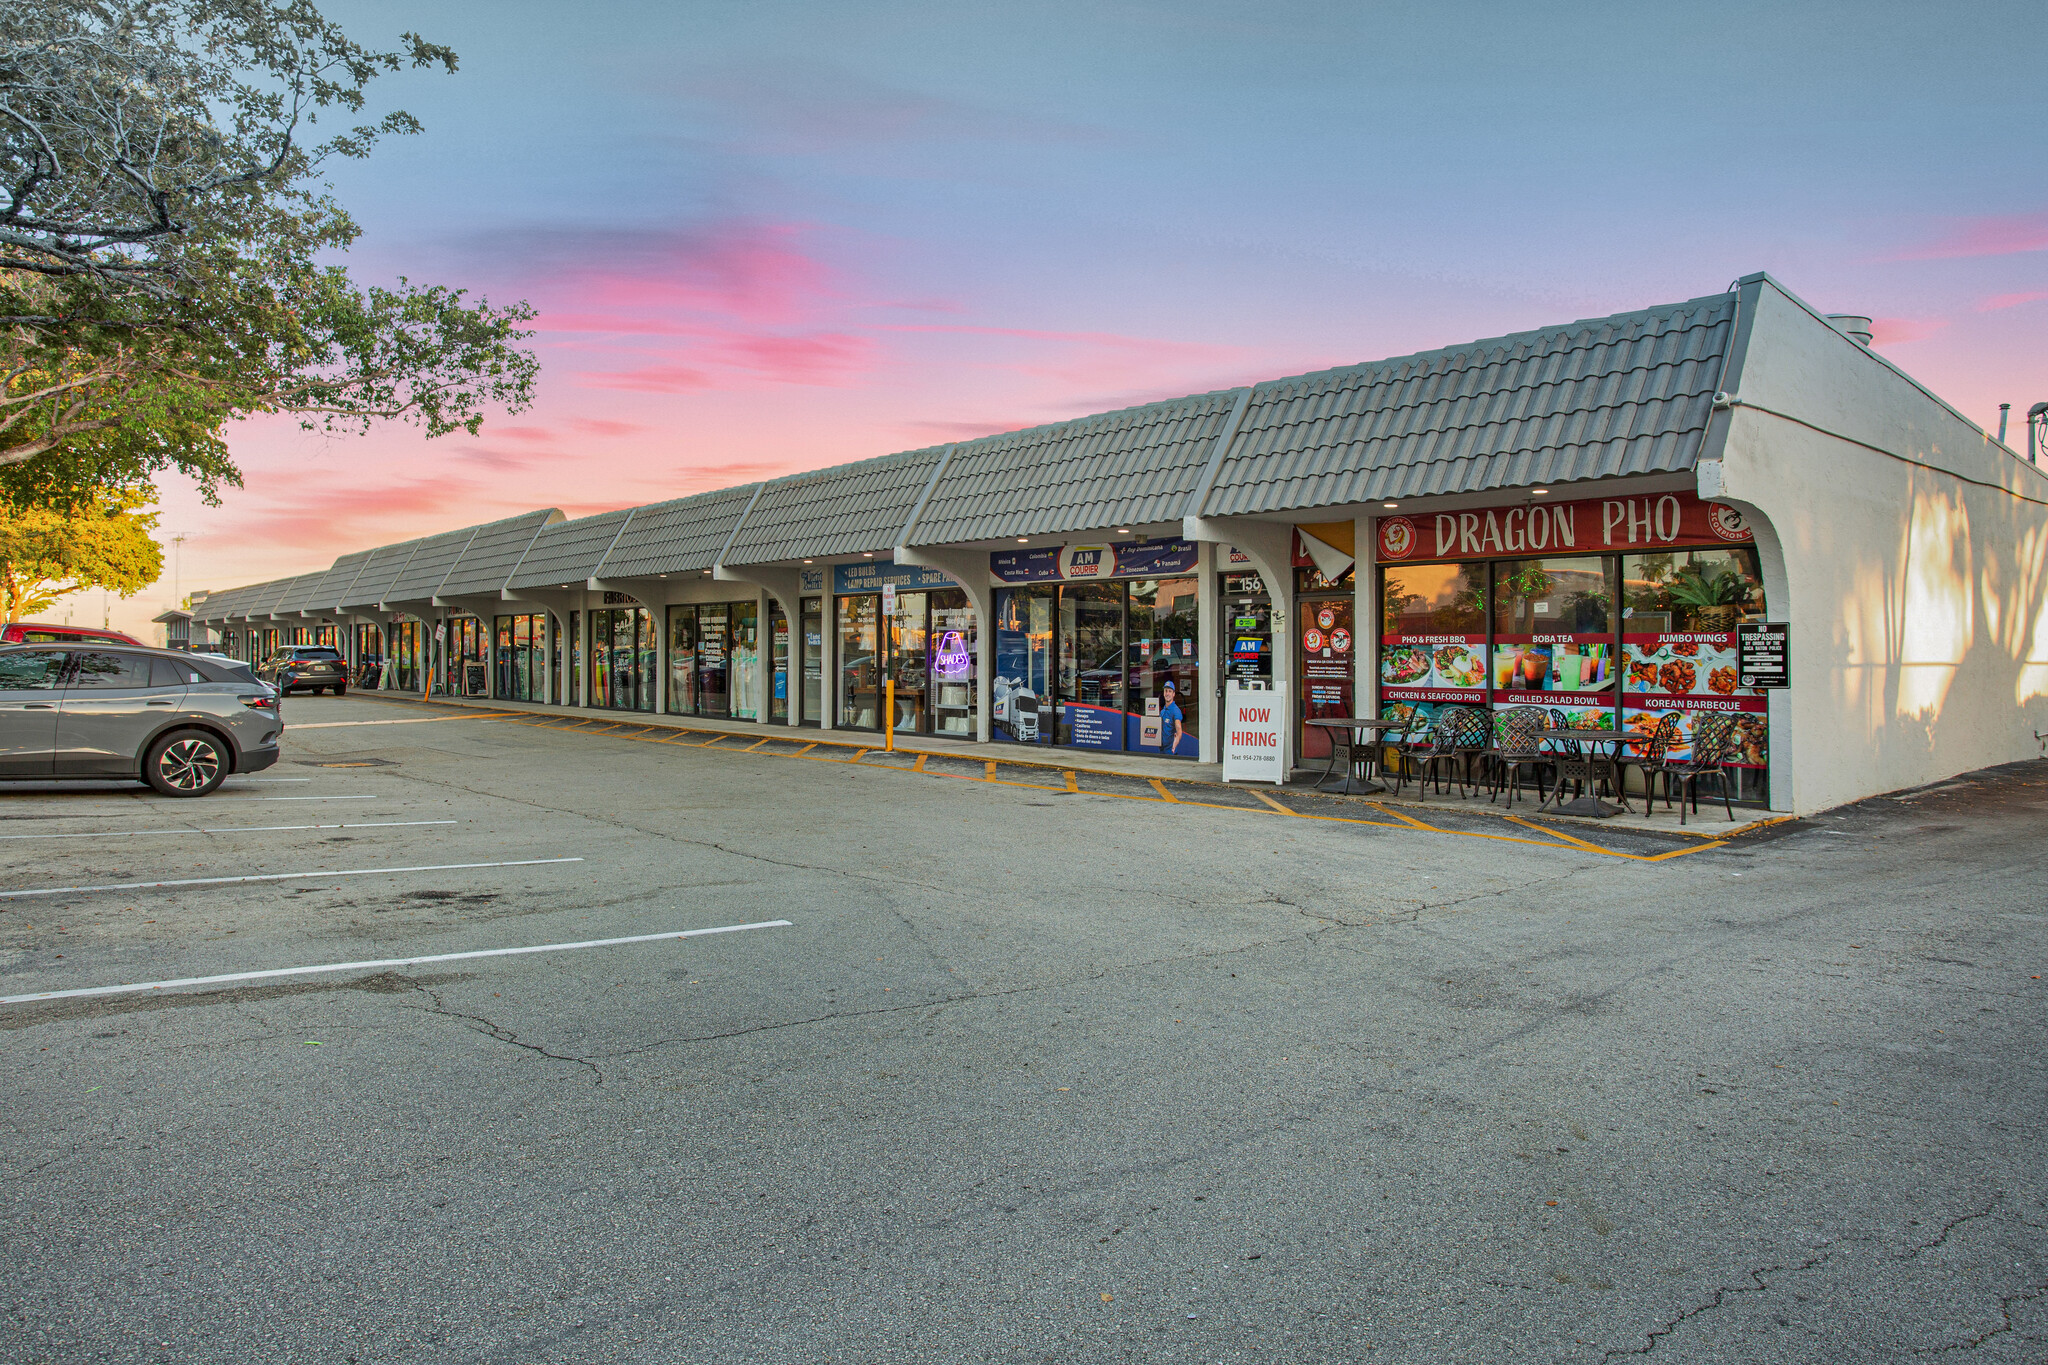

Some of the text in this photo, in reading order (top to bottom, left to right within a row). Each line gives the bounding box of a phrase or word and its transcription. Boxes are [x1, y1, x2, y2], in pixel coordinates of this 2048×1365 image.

[1435, 494, 1681, 557] DRAGON PHO
[1711, 512, 1743, 539] SCORPION
[1178, 544, 1192, 552] Brasil
[1029, 552, 1047, 560] Colombia
[1076, 552, 1094, 565] AM
[1162, 559, 1181, 567] Panamá
[848, 565, 876, 577] LED BULBS
[1069, 564, 1099, 575] COURIER
[848, 575, 911, 589] LAMP REPAIR SERVICES
[921, 572, 941, 584] SPARE
[1240, 577, 1260, 591] 156
[1449, 635, 1466, 644] BBQ
[1532, 635, 1573, 643] BOBA TEA
[1658, 633, 1728, 643] JUMBO WINGS
[1741, 633, 1785, 641] TRESPASSING
[1240, 642, 1256, 651] AM
[940, 654, 965, 665] SHADES
[1233, 652, 1259, 660] COURIER
[1388, 691, 1481, 702] CHICKEN & SEAFOOD PHO
[1508, 694, 1600, 706] GRILLED SALAD BOWL
[1645, 699, 1741, 711] KOREAN BARBEQUE
[1239, 707, 1271, 723] NOW
[1231, 731, 1277, 747] HIRING
